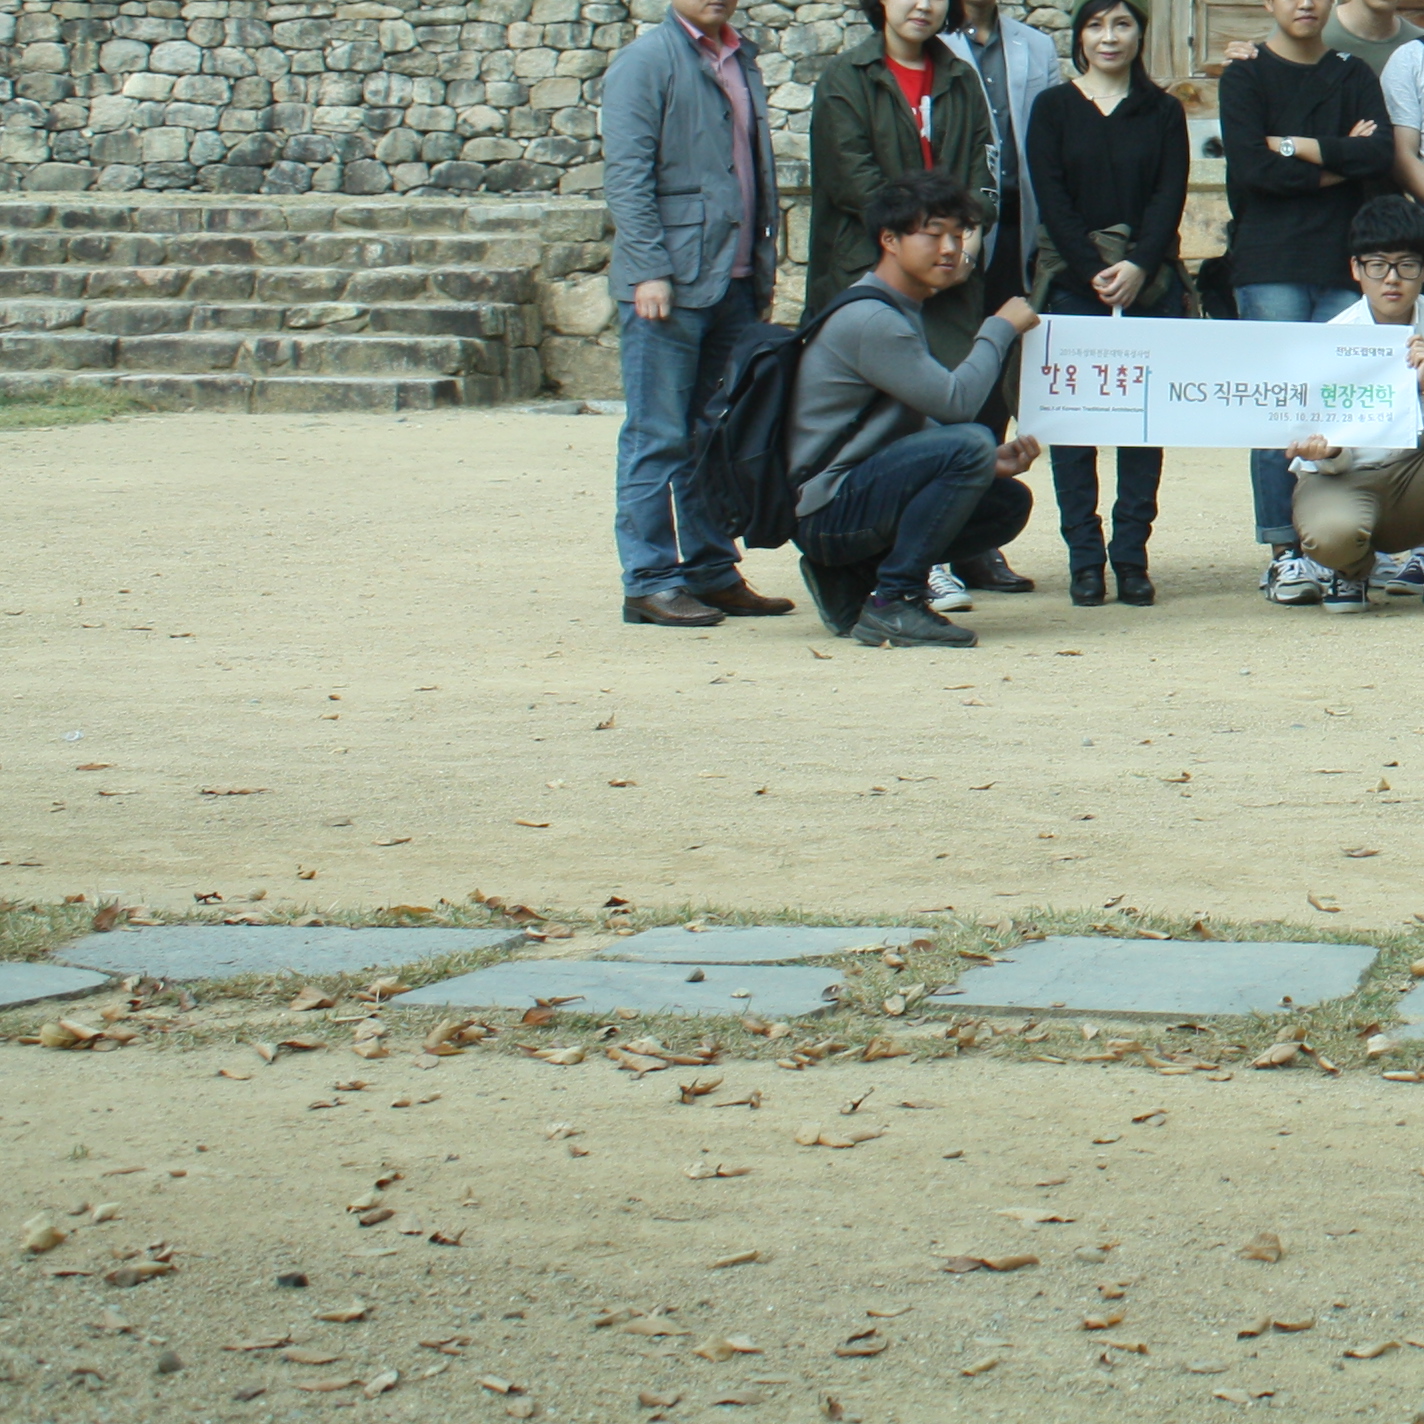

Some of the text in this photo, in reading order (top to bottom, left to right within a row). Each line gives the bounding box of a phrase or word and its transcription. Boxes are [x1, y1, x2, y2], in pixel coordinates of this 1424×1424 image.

[1336, 346, 1393, 357] 전남도립대학교
[1041, 363, 1152, 396] 한옥 건축과
[1169, 380, 1395, 409] NCS 직무산업체 현장견학
